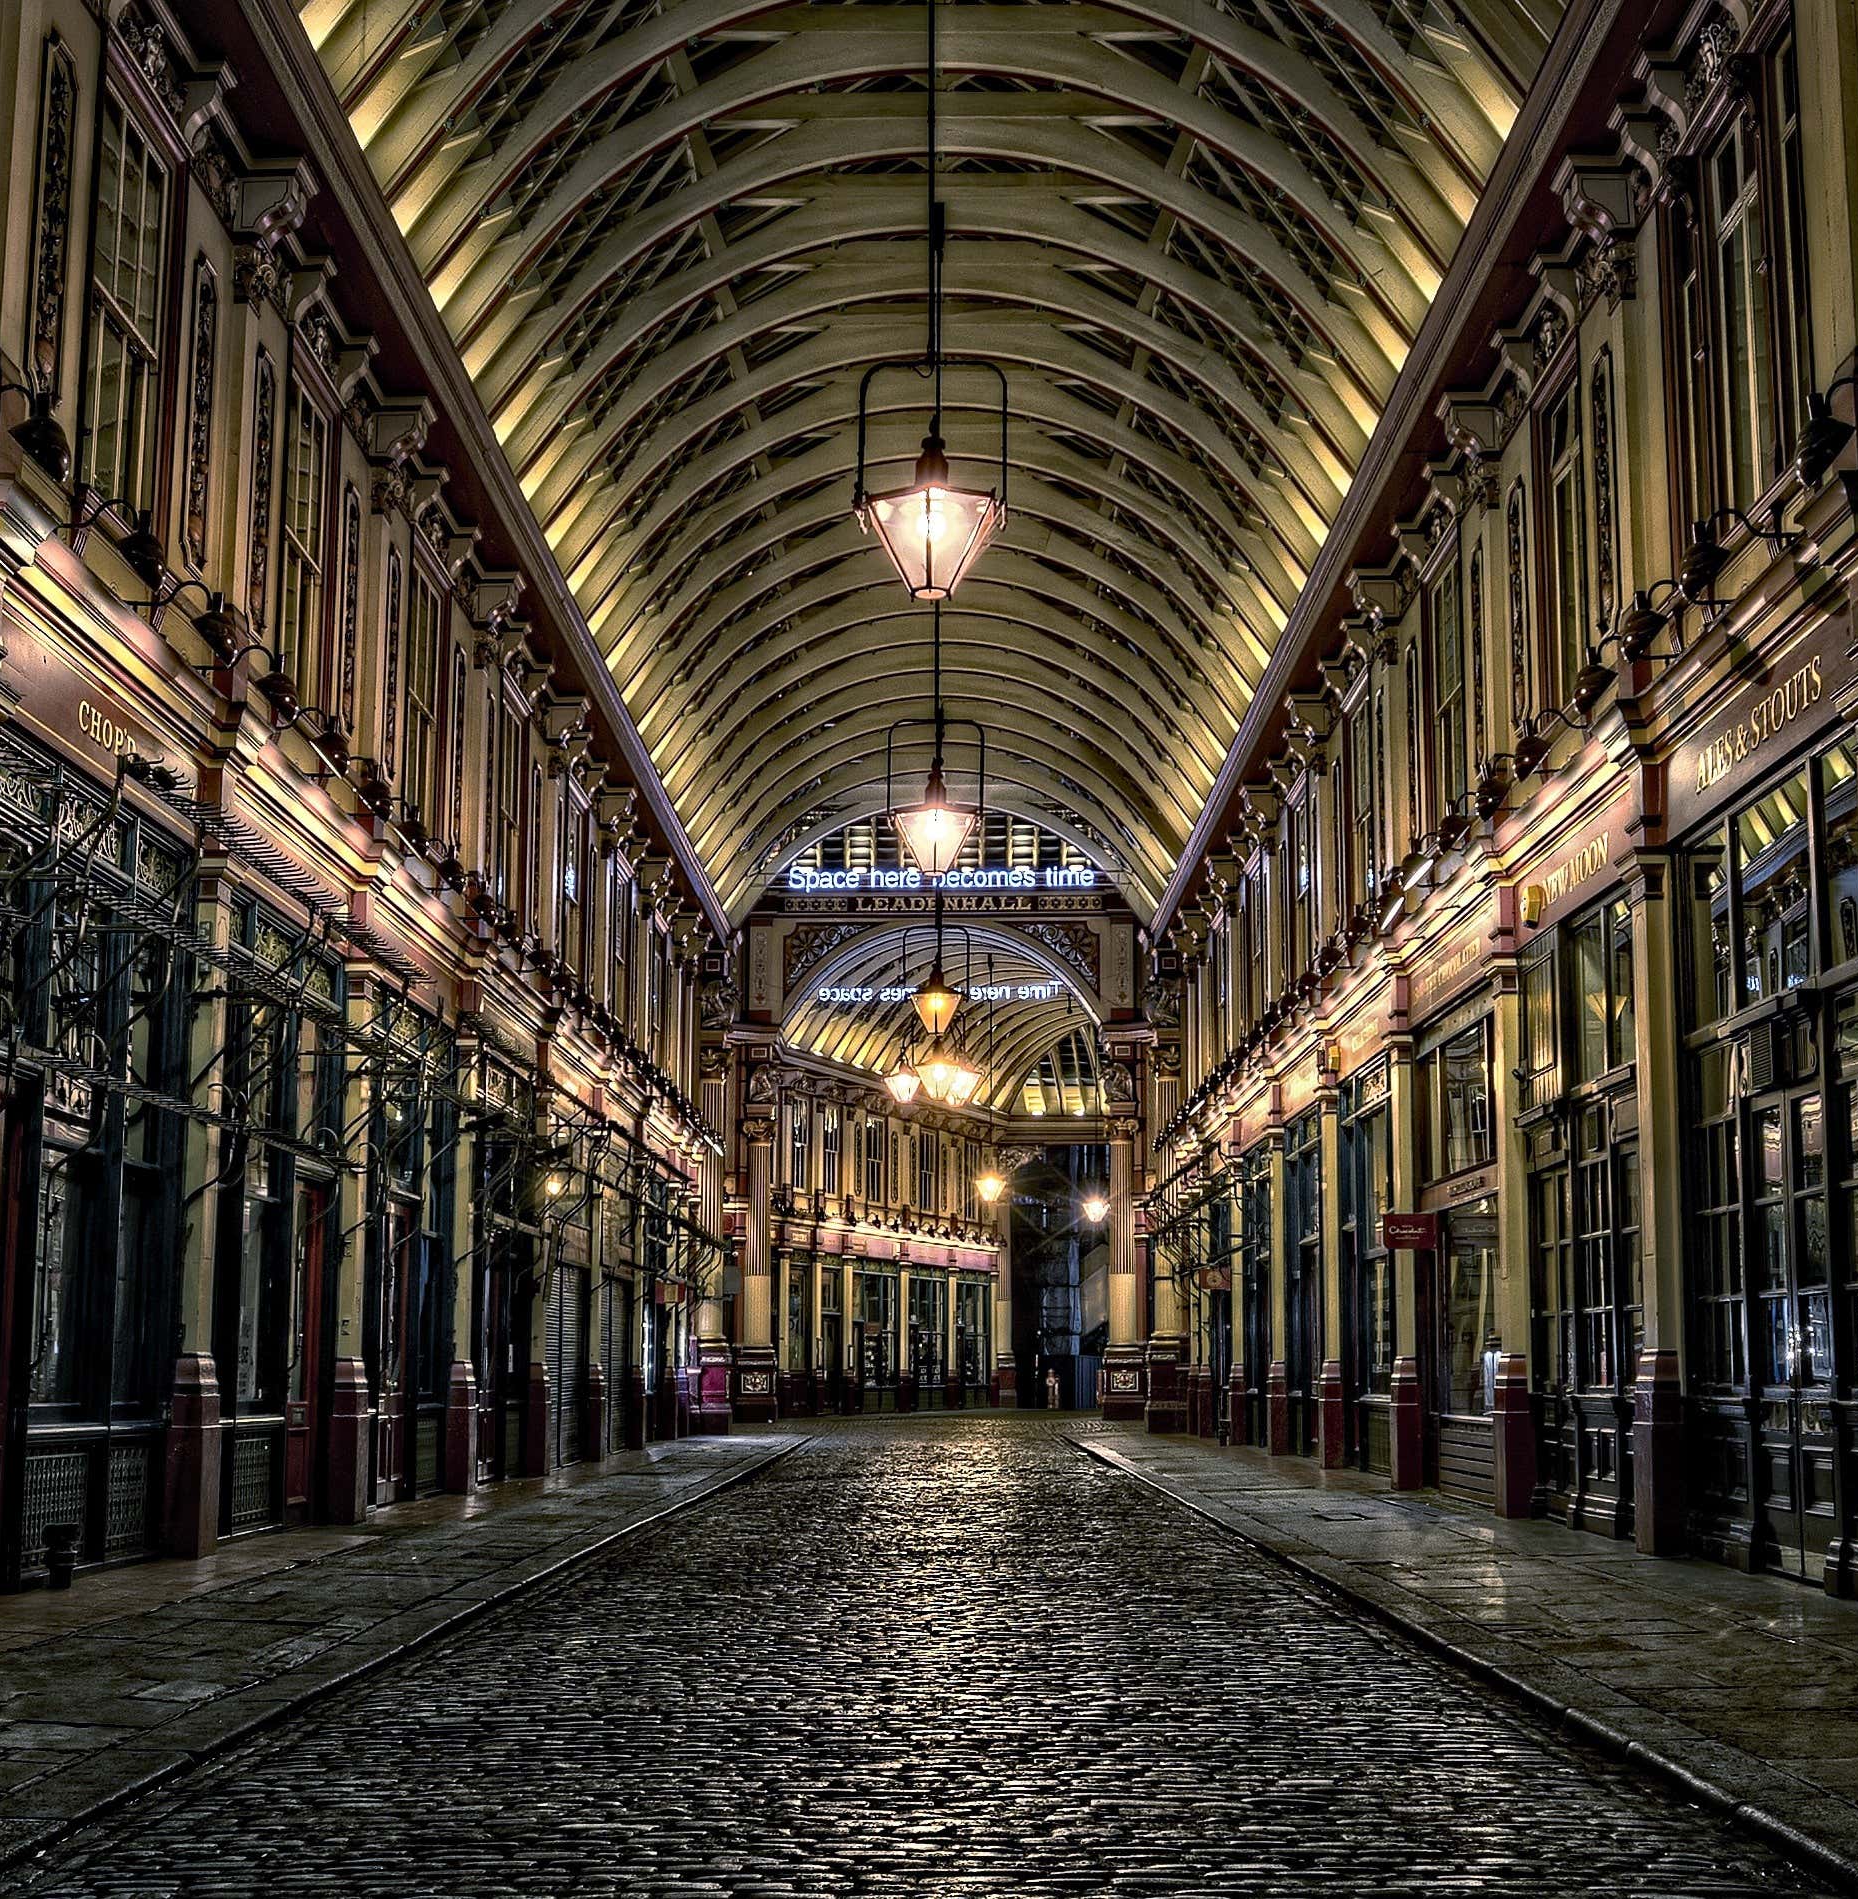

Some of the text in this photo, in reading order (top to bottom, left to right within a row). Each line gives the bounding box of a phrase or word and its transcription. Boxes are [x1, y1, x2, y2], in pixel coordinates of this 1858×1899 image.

[1696, 655, 1823, 794] ALES & STOUTS
[789, 866, 860, 893] Space
[871, 867, 920, 888] here
[1046, 866, 1094, 888] time
